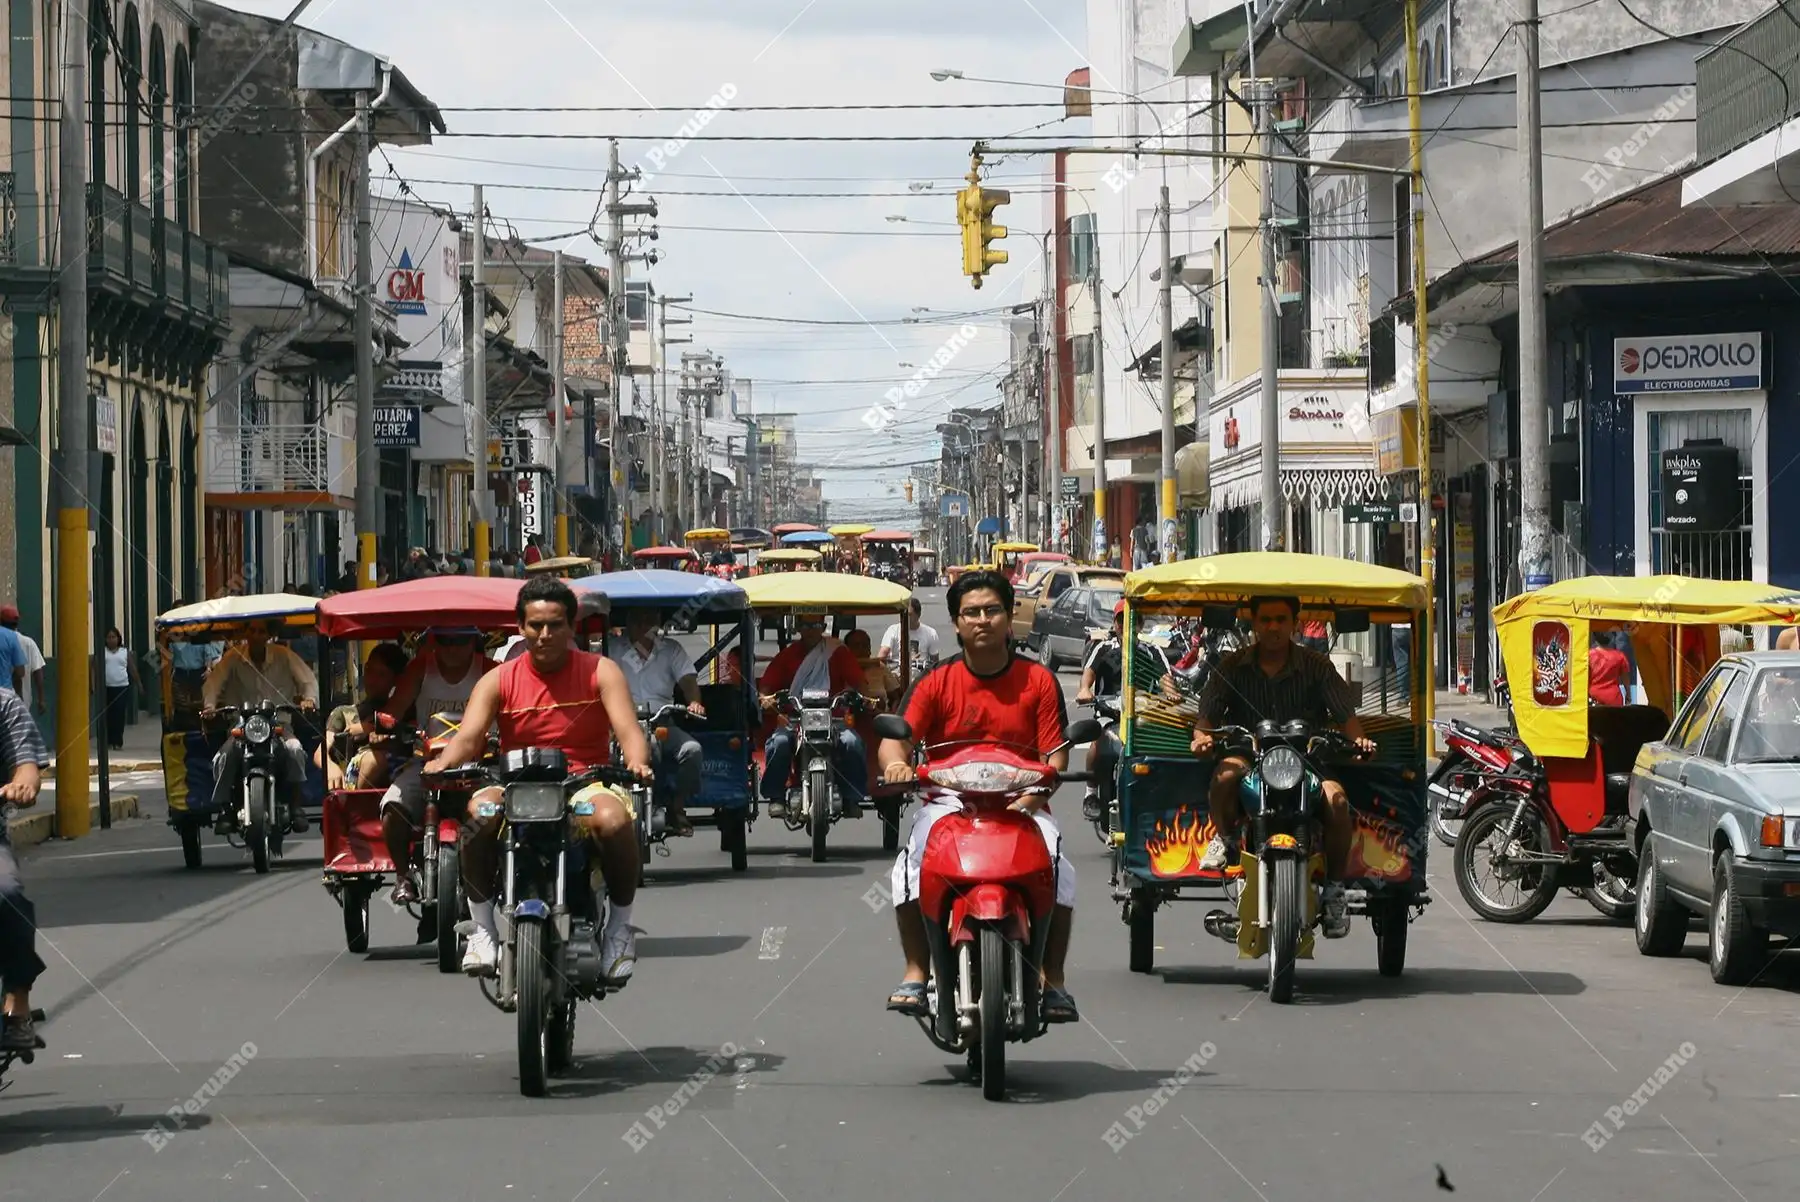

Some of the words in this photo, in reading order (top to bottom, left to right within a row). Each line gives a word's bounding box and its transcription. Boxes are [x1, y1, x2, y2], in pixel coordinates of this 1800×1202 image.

[388, 270, 425, 301] GM
[1643, 343, 1755, 374] PEDROLLO
[1644, 379, 1731, 390] ELECTROBOMBAS
[1304, 396, 1329, 405] HOTEL
[1289, 407, 1344, 422] Sandalo
[374, 423, 408, 436] PEREZ
